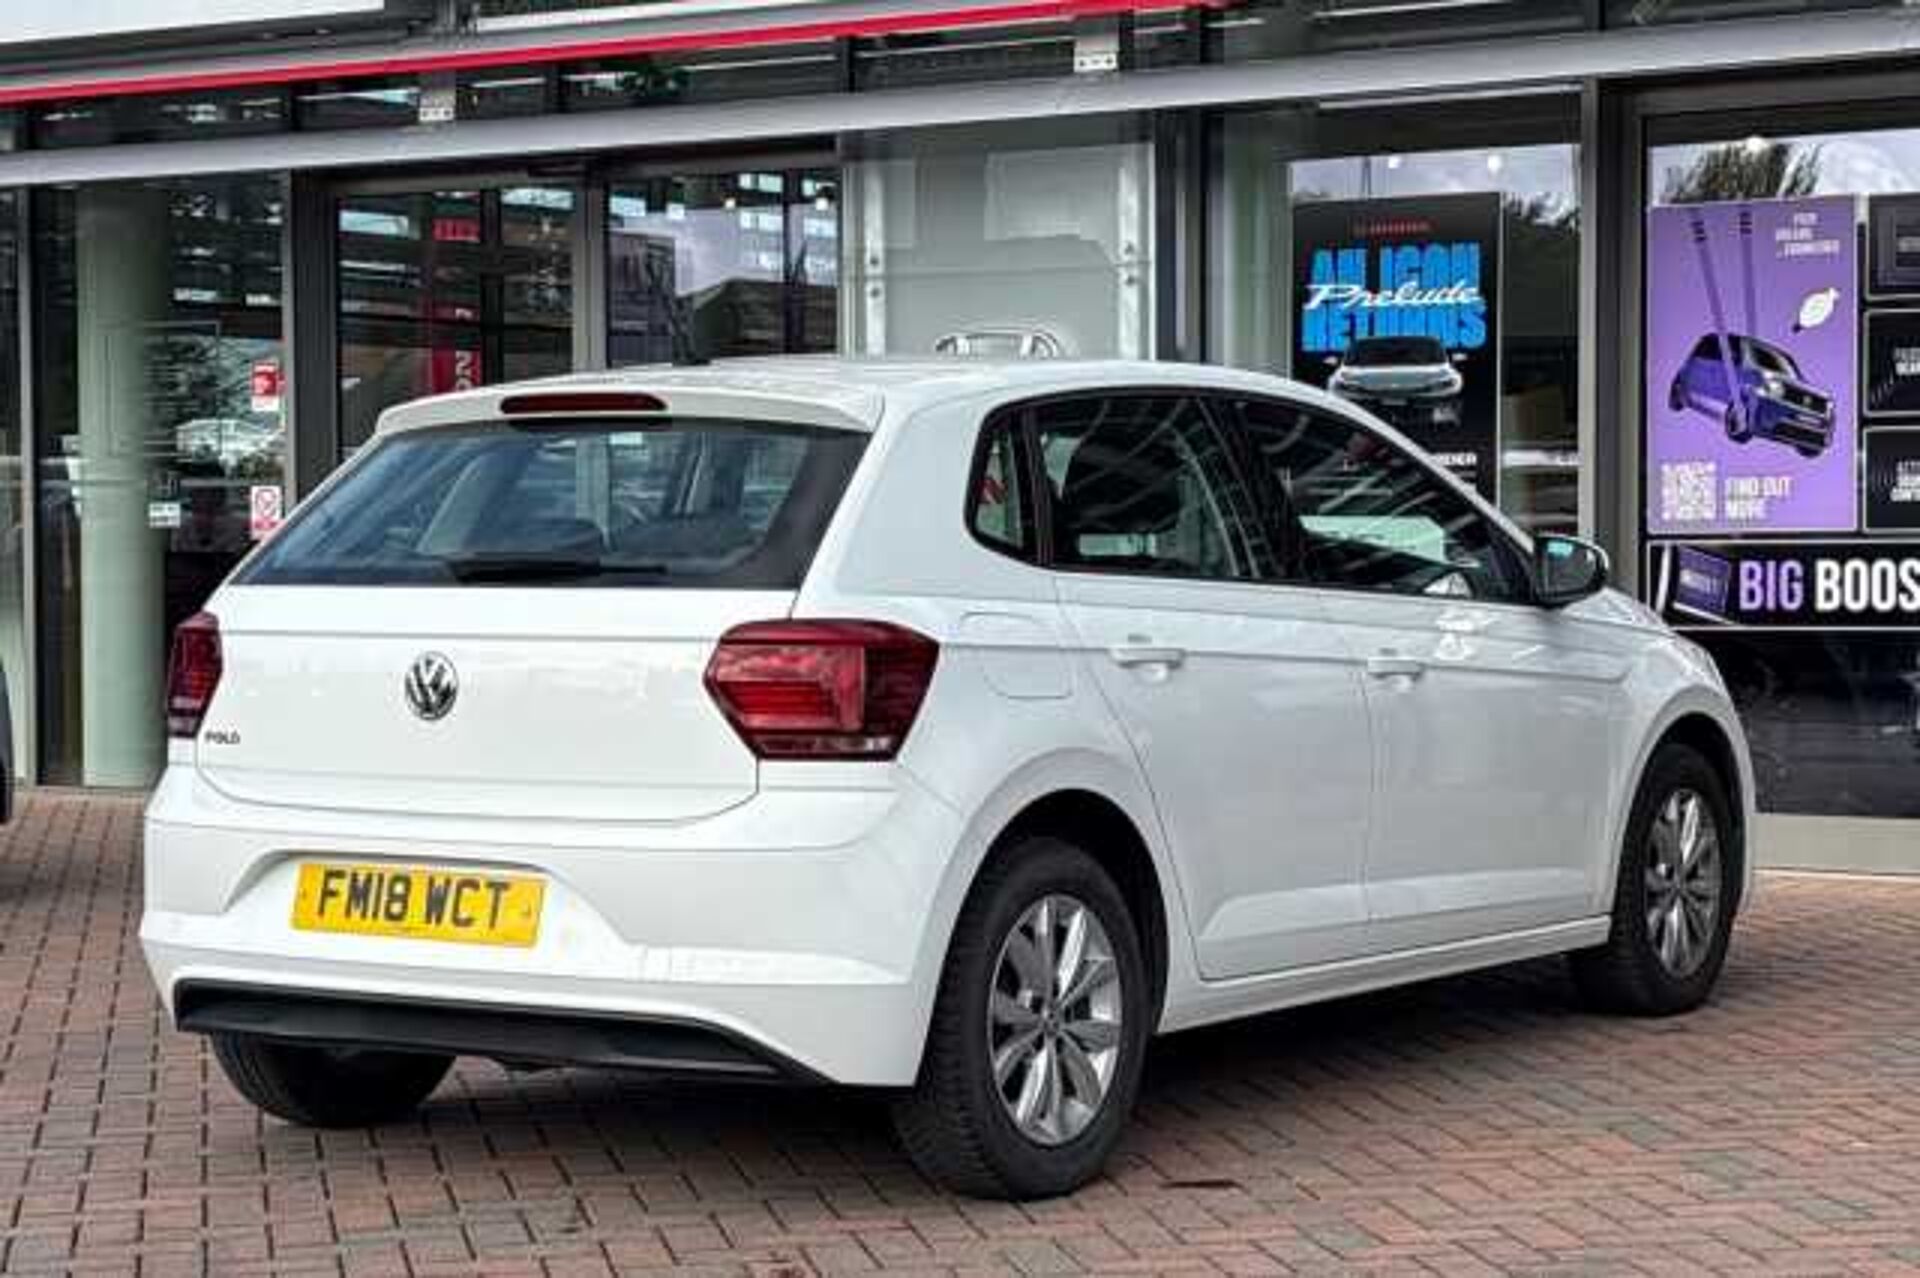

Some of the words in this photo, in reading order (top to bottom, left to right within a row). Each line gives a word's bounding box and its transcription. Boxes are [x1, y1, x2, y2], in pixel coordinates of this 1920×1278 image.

[1302, 279, 1482, 311] Prelude
[1739, 559, 1805, 612] BIG
[1815, 558, 1920, 613] BOOS
[204, 729, 241, 746] POLO
[316, 868, 412, 922] FM18
[424, 874, 511, 930] WCT
